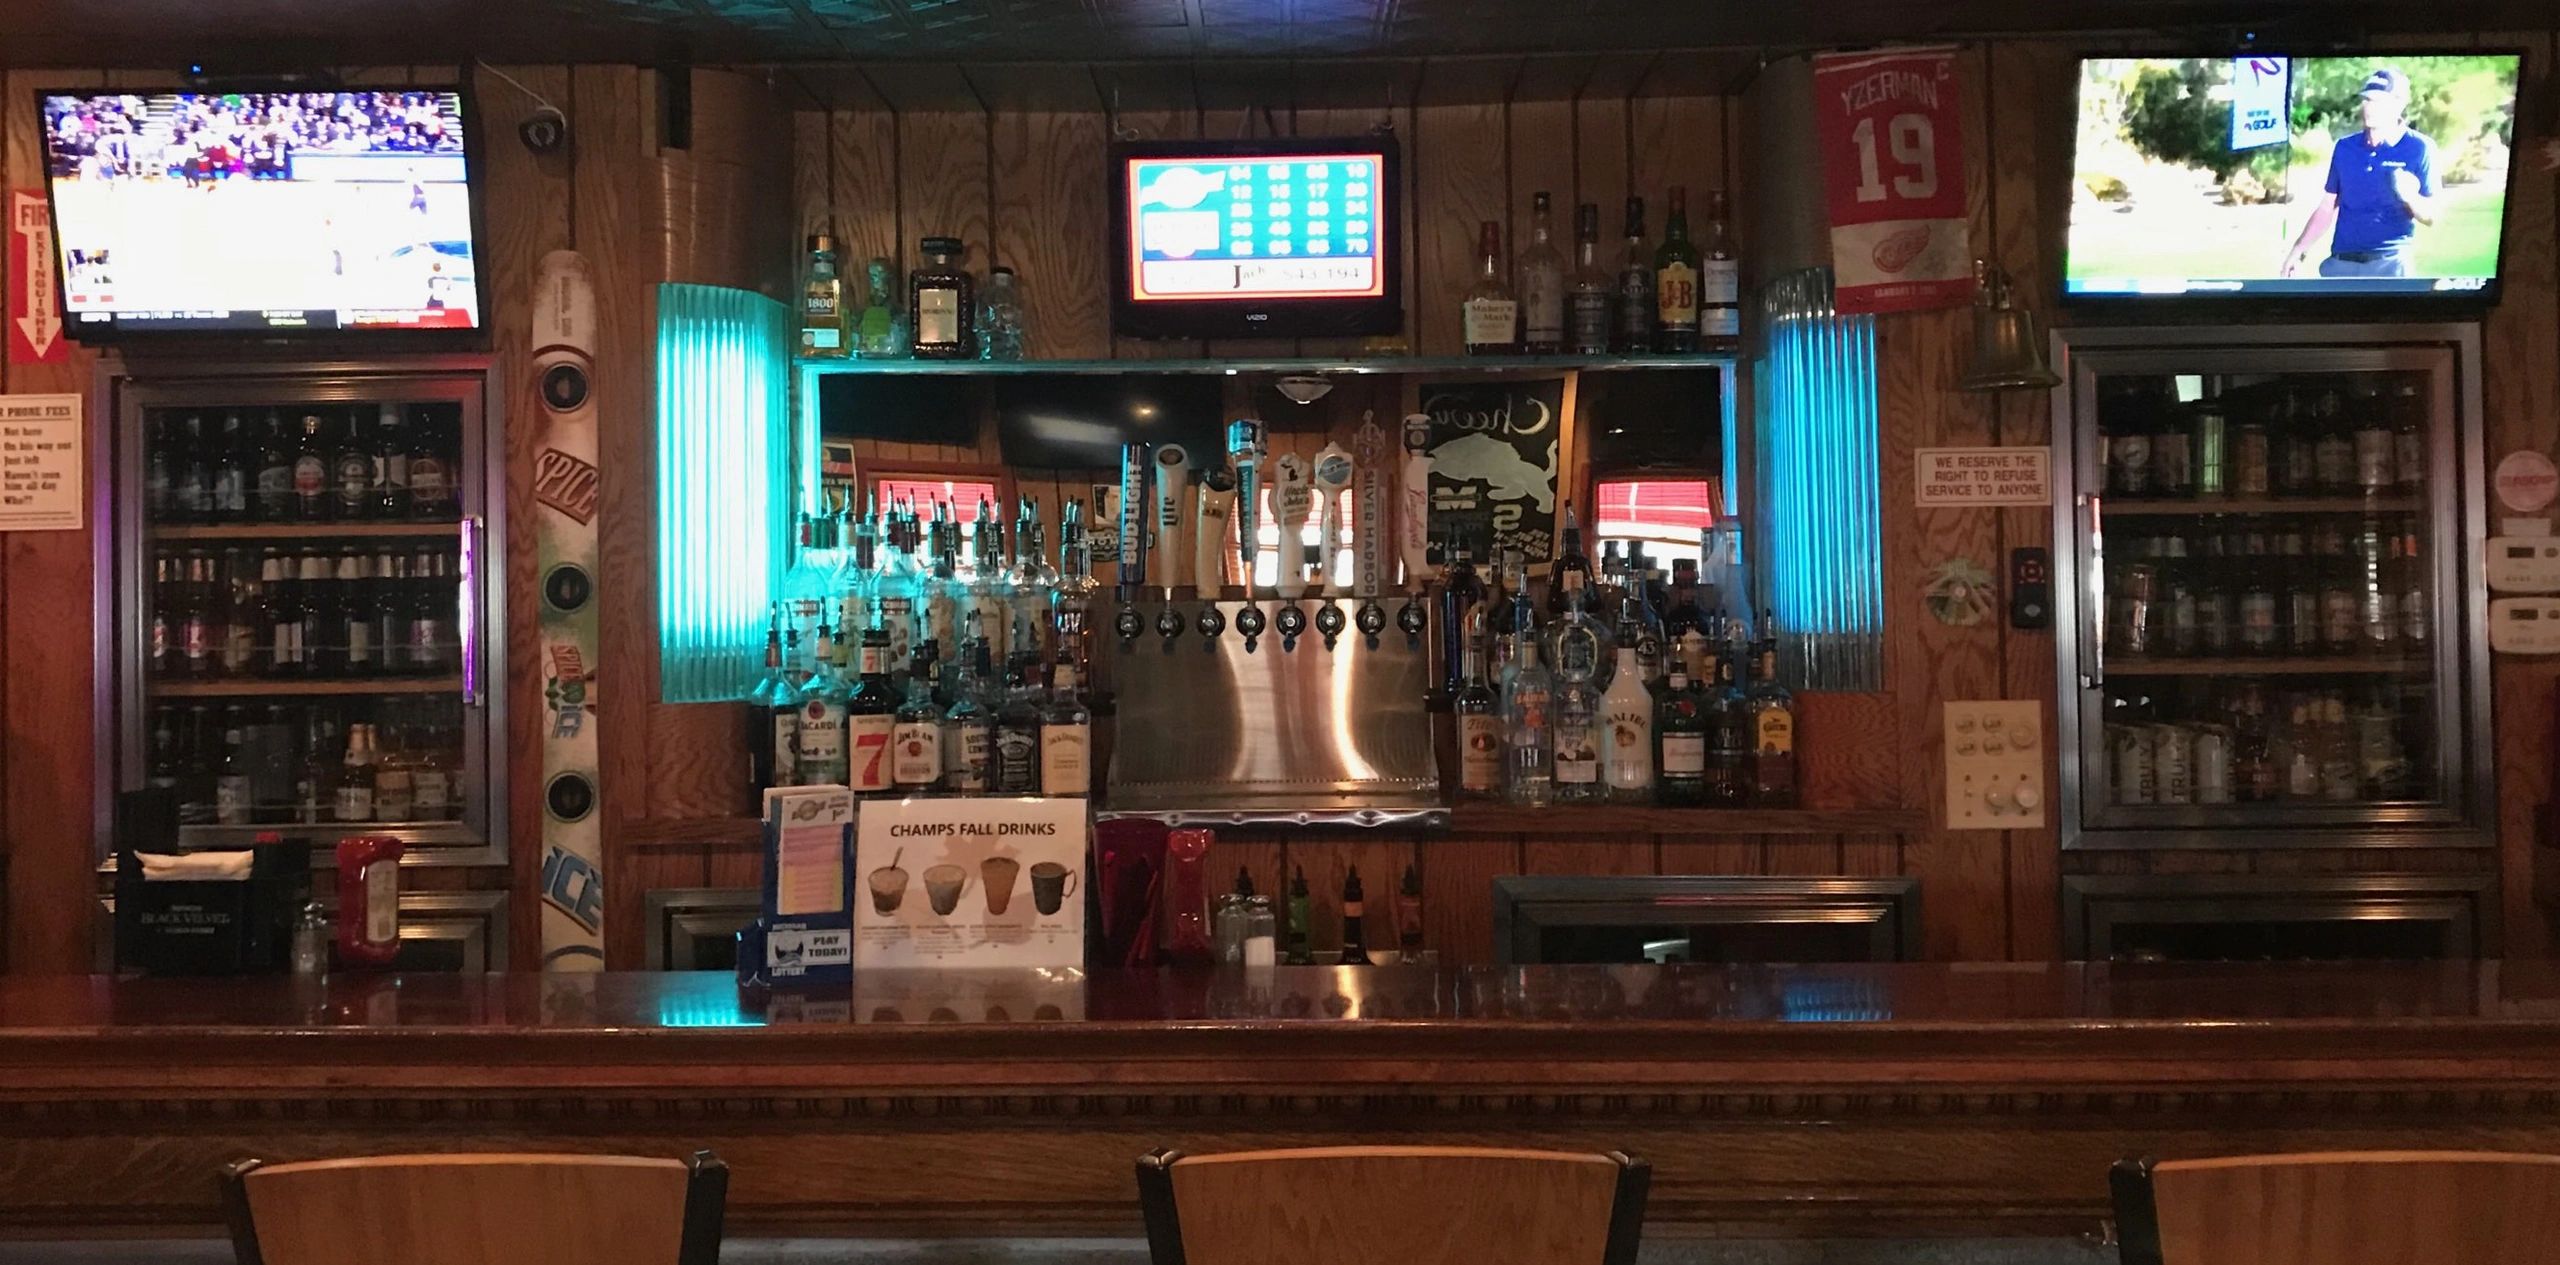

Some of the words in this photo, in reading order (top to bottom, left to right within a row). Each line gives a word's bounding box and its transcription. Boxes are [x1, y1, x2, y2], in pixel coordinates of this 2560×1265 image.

[1936, 61, 1950, 81] C
[1840, 70, 1939, 117] YZERMAN
[1851, 113, 1939, 203] 19
[21, 204, 50, 226] FIR
[35, 231, 47, 345] EXTINGUISHER
[807, 297, 834, 308] 1800
[1246, 313, 1268, 321] VIZIO
[8, 407, 41, 417] PHONE
[46, 406, 71, 416] FEES
[1935, 456, 1953, 468] WE
[1958, 456, 2009, 468] RESERVE
[2015, 456, 2036, 467] THE
[1934, 471, 1968, 482] RIGHT
[1974, 470, 1989, 481] TO
[1994, 470, 2037, 481] REFUSE
[535, 451, 598, 517] SPICE
[1124, 462, 1142, 520] LIGHT
[1925, 485, 1972, 496] SERVICE
[1977, 484, 1992, 495] TO
[1997, 484, 2044, 496] ANYONE
[1364, 469, 1377, 522] SILVER
[1121, 522, 1139, 565] BUD
[1364, 526, 1377, 596] HARBOR
[1637, 640, 1656, 655] 43
[864, 654, 877, 669] 7
[855, 733, 889, 786] 7
[890, 824, 955, 837] CHAMPS
[960, 823, 993, 836] FALL
[998, 822, 1056, 836] DRINKS
[140, 912, 182, 924] BLACK
[812, 935, 840, 945] PLAY
[808, 947, 848, 958] TODAY!
